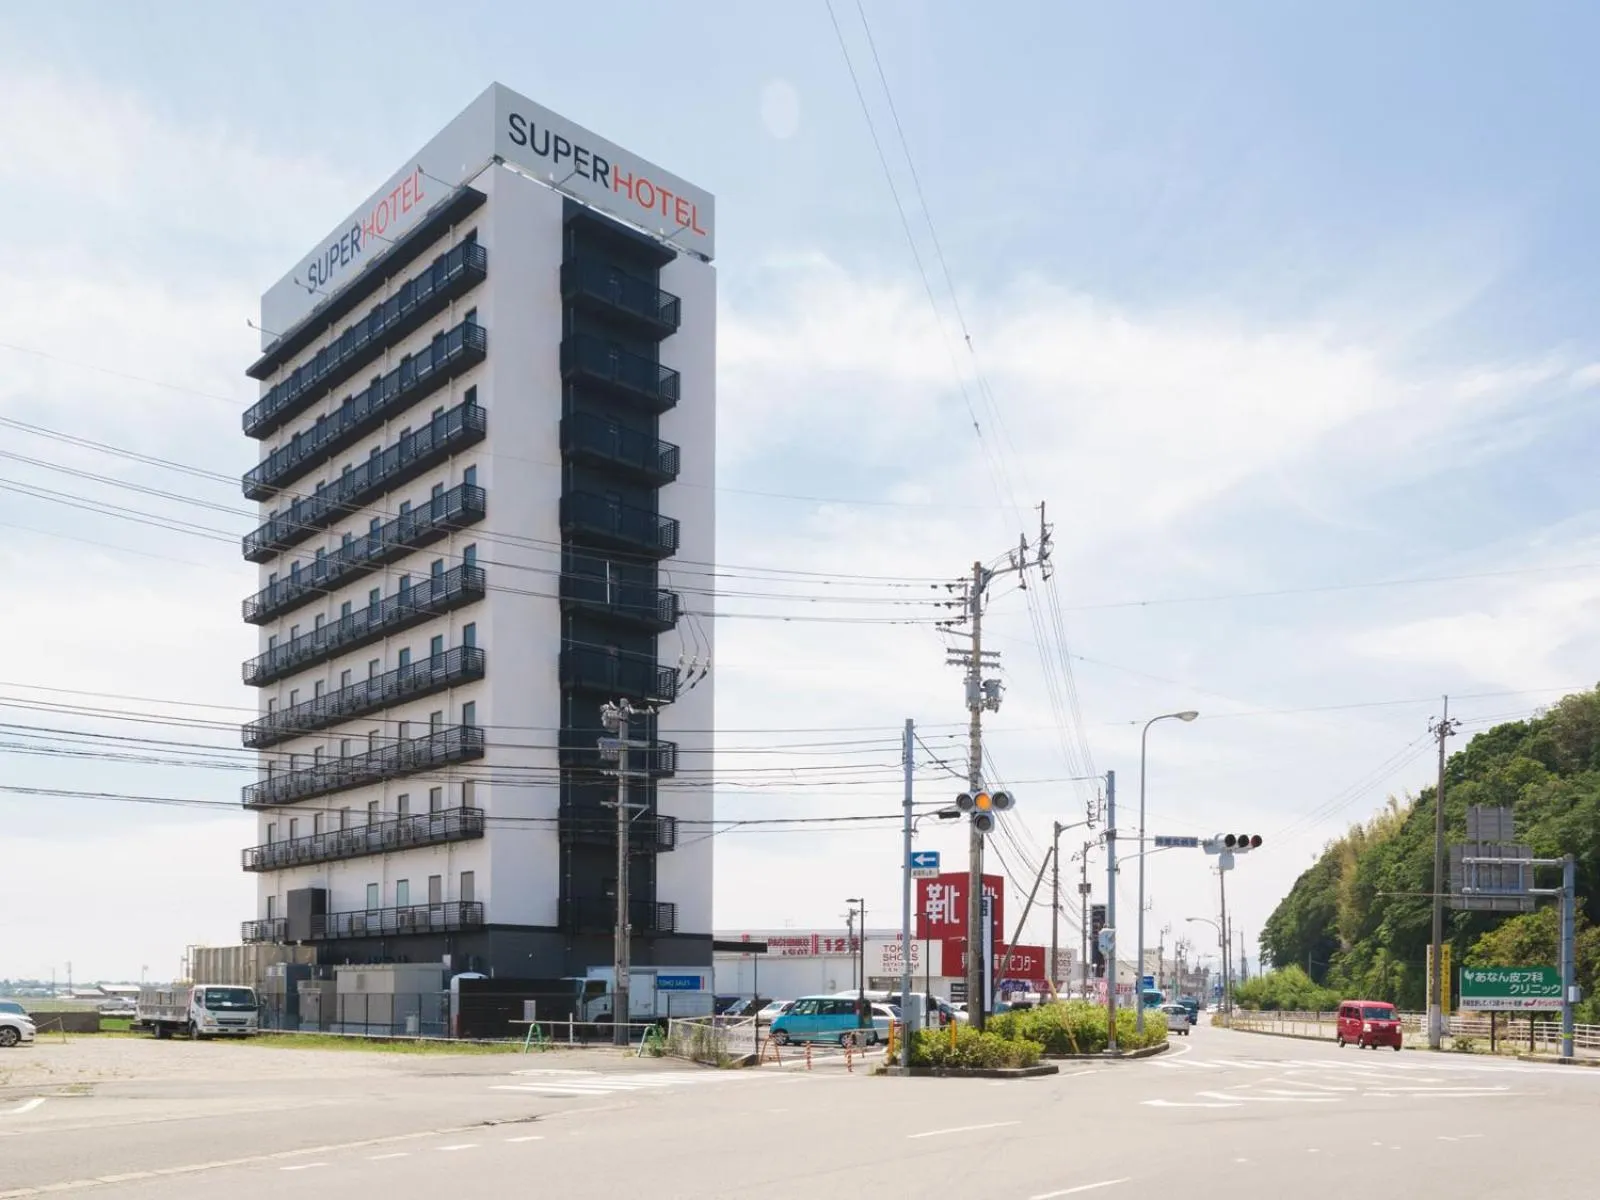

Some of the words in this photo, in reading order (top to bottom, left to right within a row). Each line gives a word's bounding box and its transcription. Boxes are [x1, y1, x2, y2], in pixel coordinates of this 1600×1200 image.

[925, 883, 960, 925] 靴
[882, 944, 919, 953] TOKO
[882, 953, 919, 962] SHOS
[1474, 972, 1544, 983] あなん皮フ科
[1509, 984, 1561, 994] クリニック
